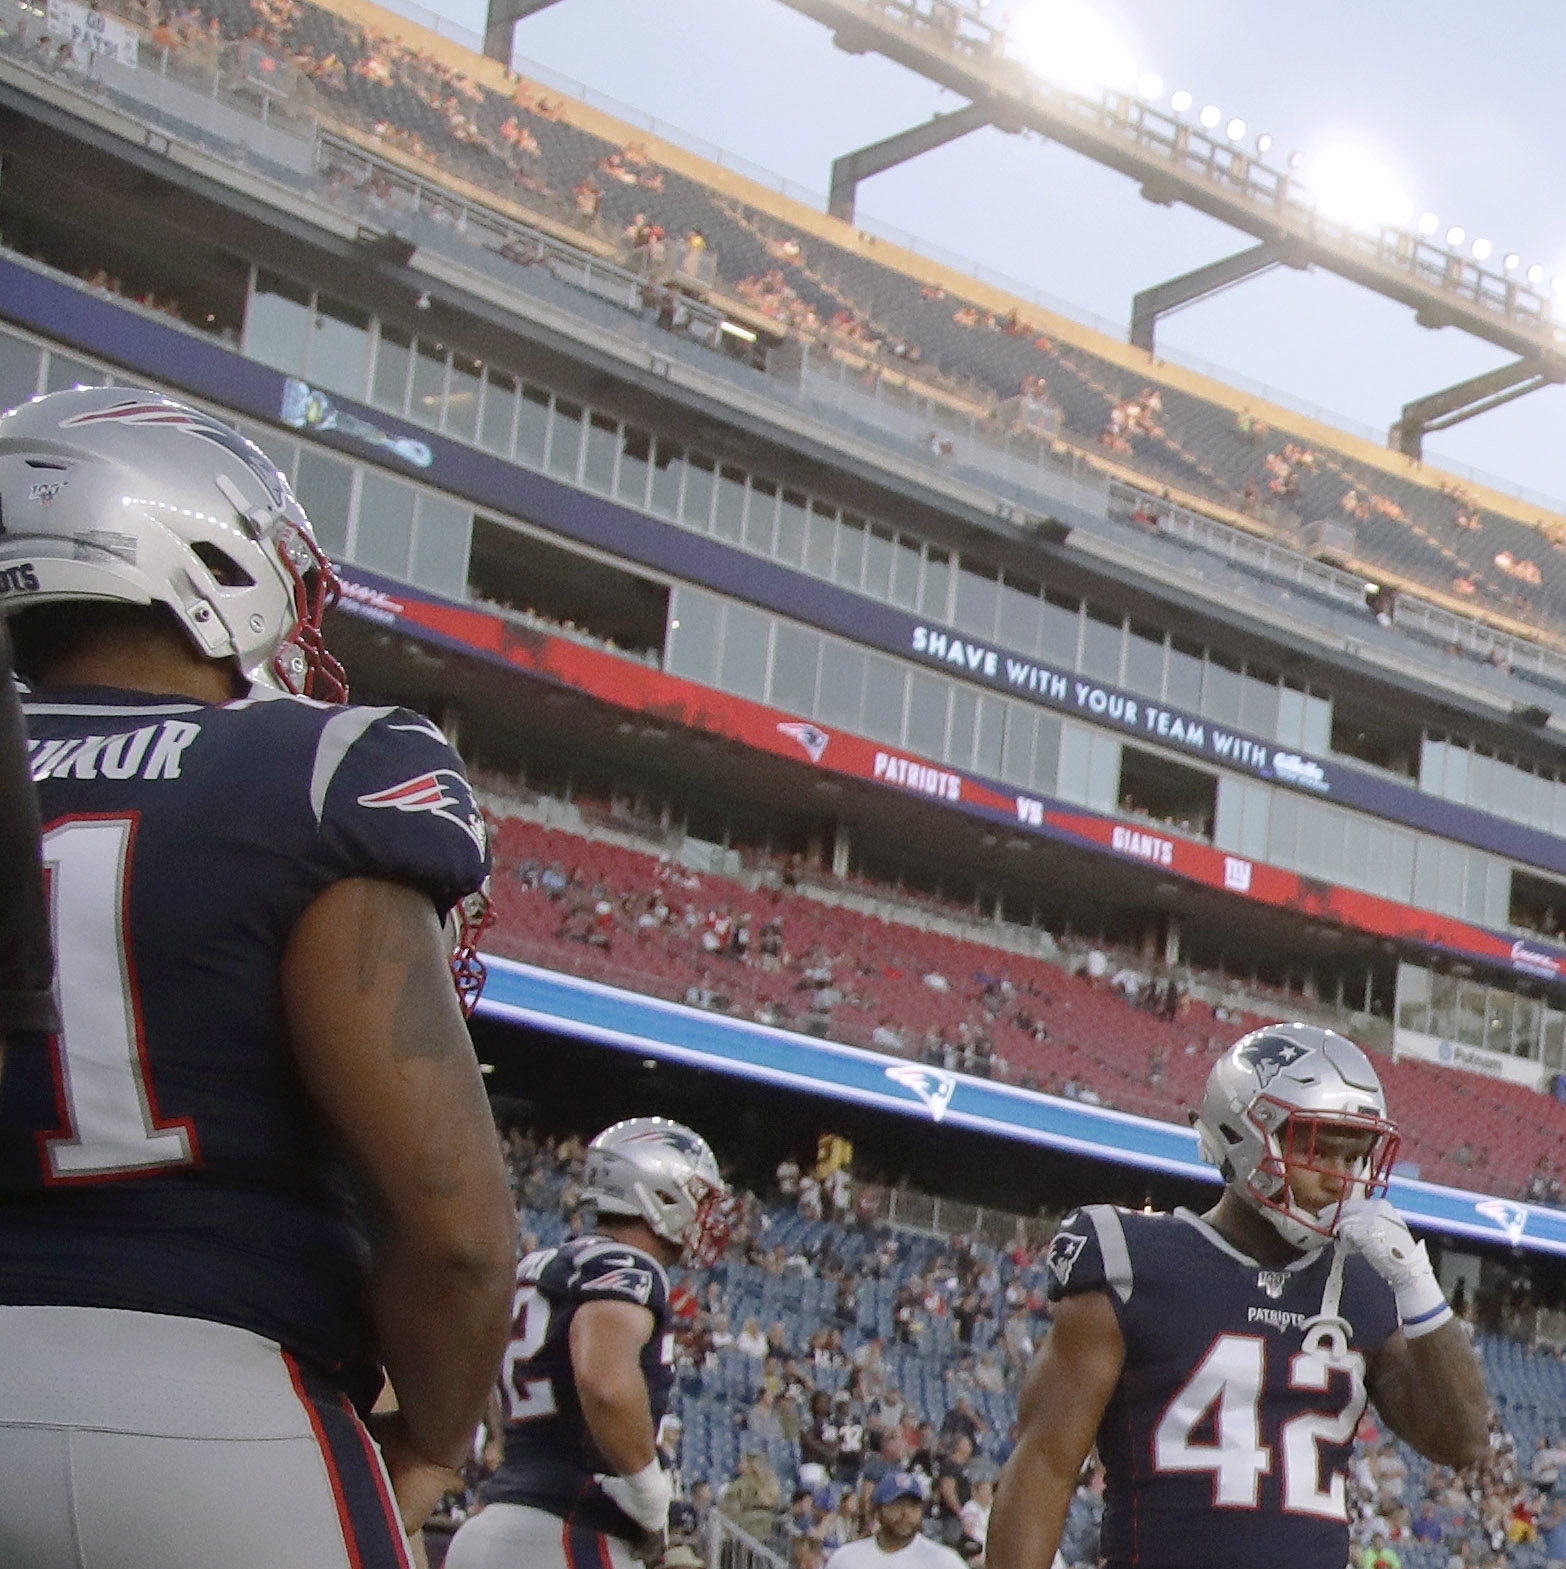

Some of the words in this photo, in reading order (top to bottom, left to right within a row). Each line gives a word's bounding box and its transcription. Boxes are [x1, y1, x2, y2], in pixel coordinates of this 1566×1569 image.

[26, 719, 202, 782] UNOR
[912, 626, 999, 677] SHAVE
[1006, 658, 1068, 700] WITH
[1075, 682, 1139, 725] YOUR
[1145, 707, 1204, 748] TEAM
[1213, 730, 1268, 769] WITH
[873, 751, 961, 801] PATRIOTS
[1016, 796, 1045, 827] VS
[1113, 826, 1173, 866] GIANTS
[1151, 1332, 1366, 1522] 42
